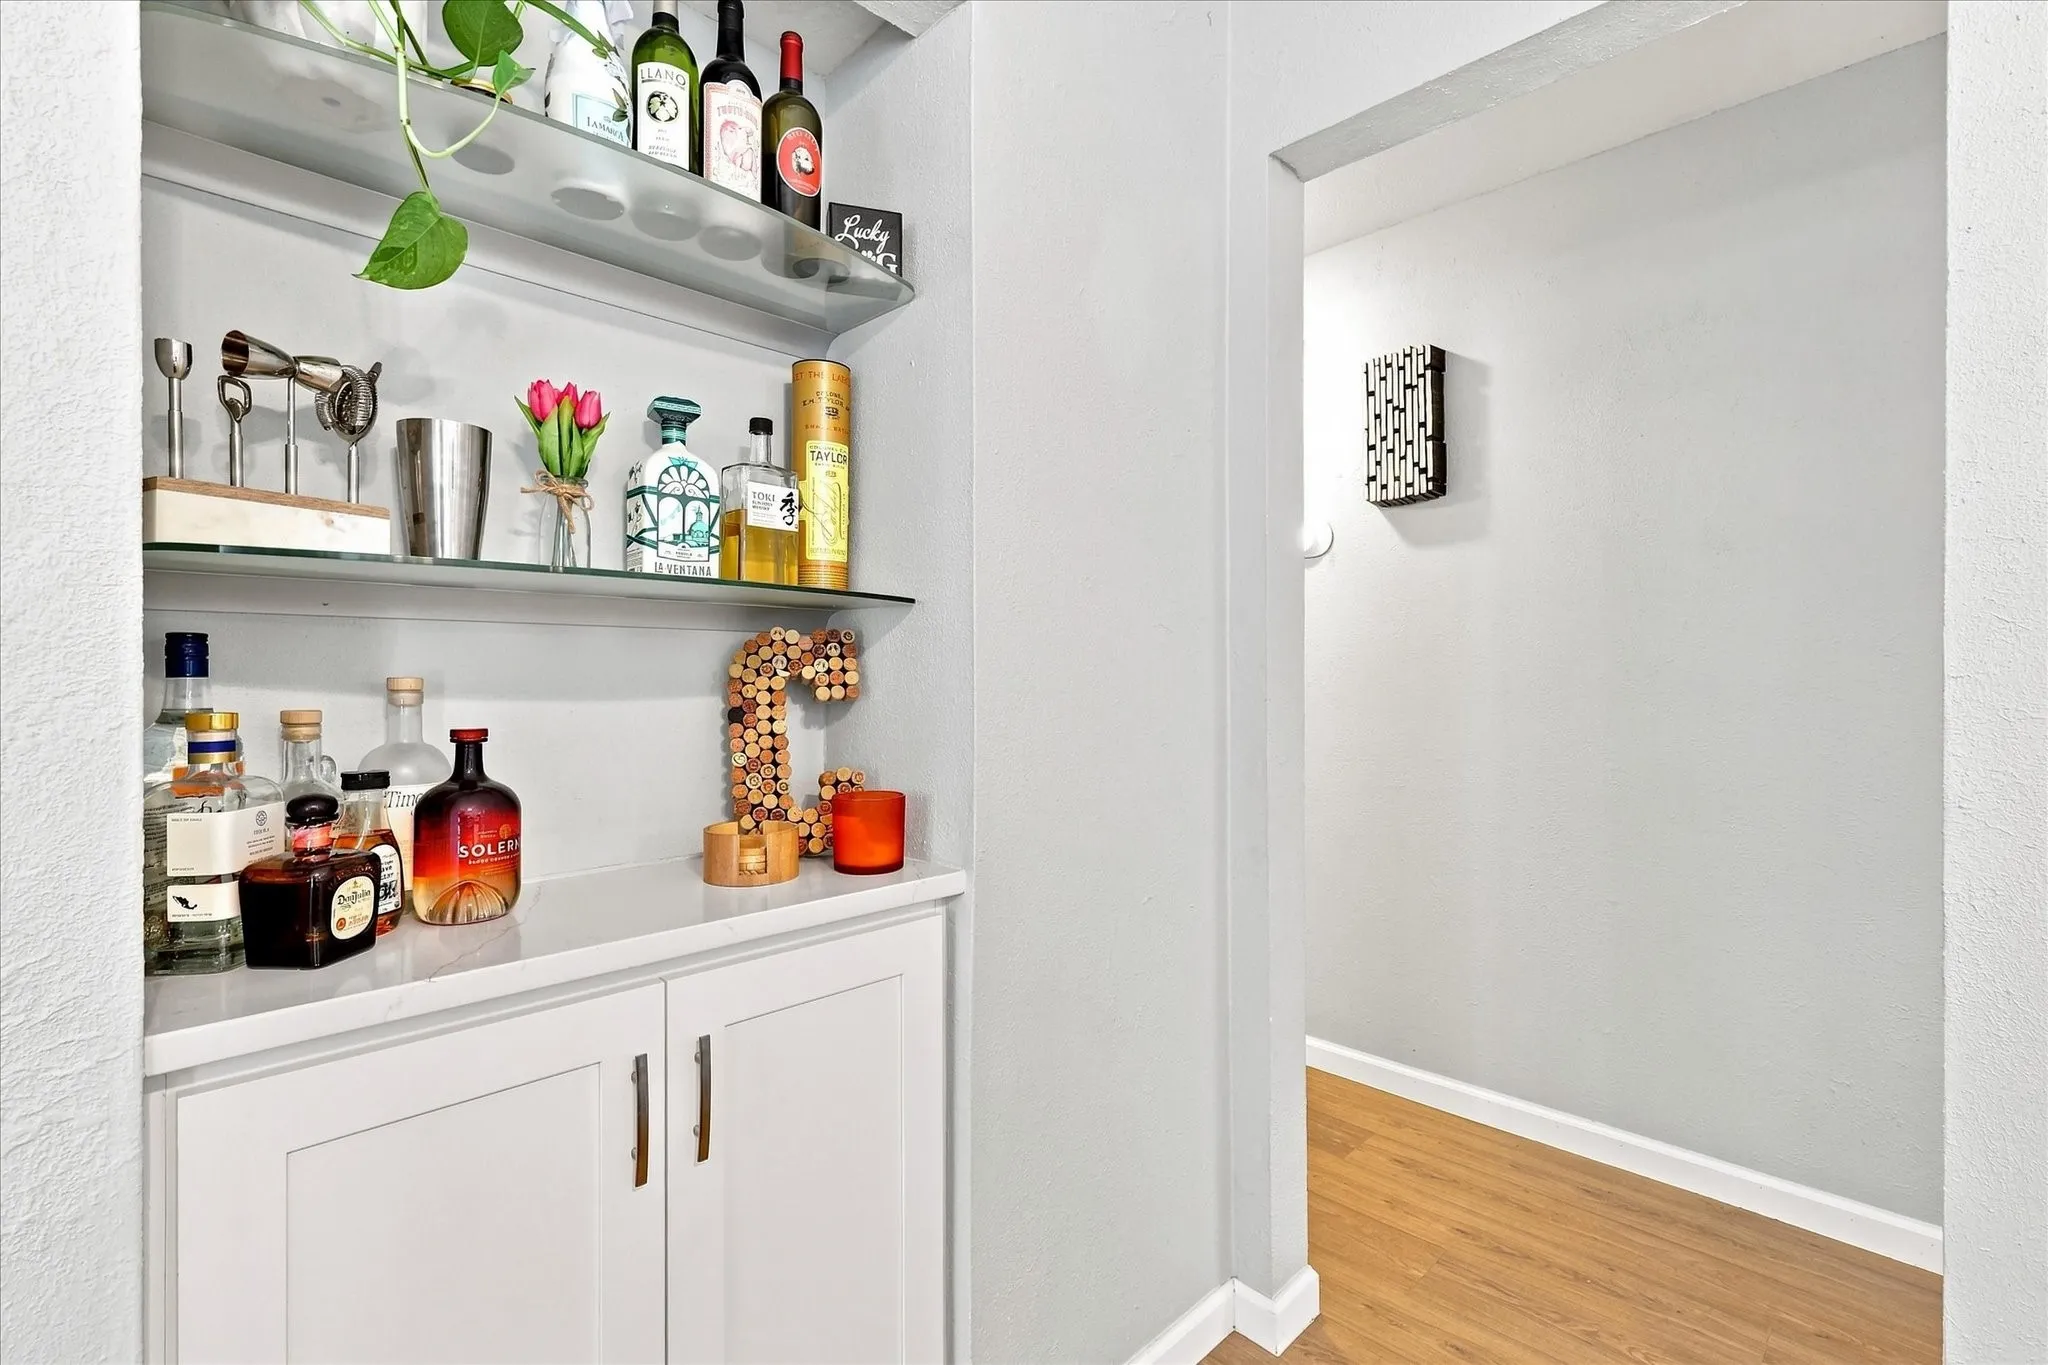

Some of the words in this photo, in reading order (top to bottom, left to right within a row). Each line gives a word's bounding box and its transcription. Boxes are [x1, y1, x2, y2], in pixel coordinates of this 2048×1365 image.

[640, 68, 686, 86] LLANO
[834, 214, 890, 254] Lucky
[809, 450, 848, 466] TAYLOR
[752, 491, 775, 502] TOKI
[654, 561, 664, 574] LA
[666, 563, 712, 577] VENTANA
